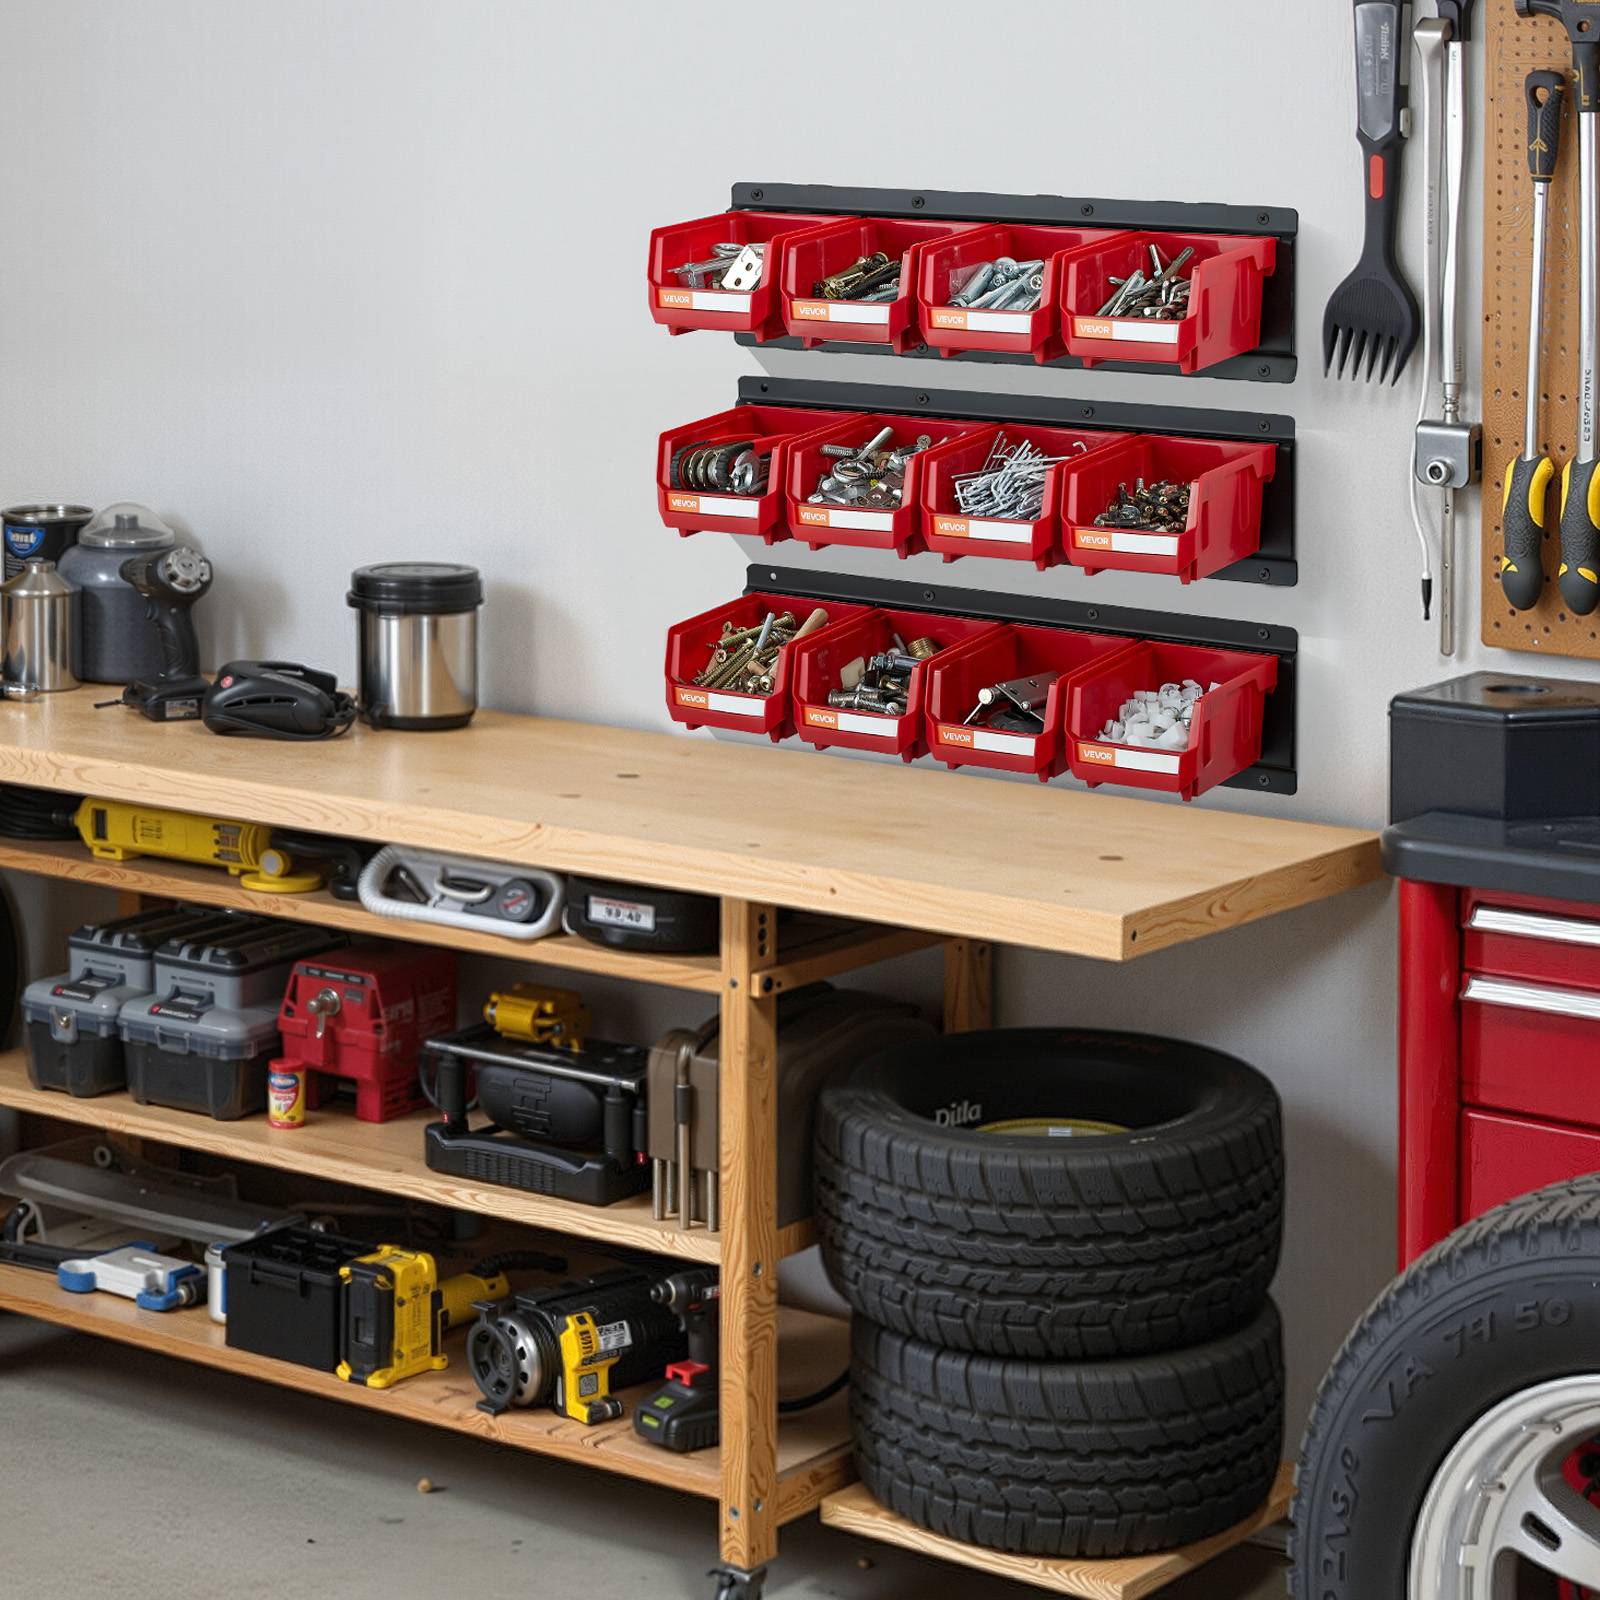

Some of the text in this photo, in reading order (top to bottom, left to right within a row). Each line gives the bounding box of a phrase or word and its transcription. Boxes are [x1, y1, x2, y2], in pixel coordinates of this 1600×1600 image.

[664, 294, 690, 304] VEVOR
[799, 306, 826, 316] VEVOR
[936, 314, 963, 325] VEVOR
[1080, 325, 1109, 335] VEVOR
[672, 499, 698, 508] VEVOR
[800, 512, 826, 521] VEVOR
[938, 523, 966, 533] VEVOR
[1080, 535, 1109, 545] VEVOR
[680, 694, 707, 704] VEVOR
[809, 713, 836, 724] VEVOR
[943, 732, 971, 743] VEVOR
[1084, 750, 1112, 761] VEVOR
